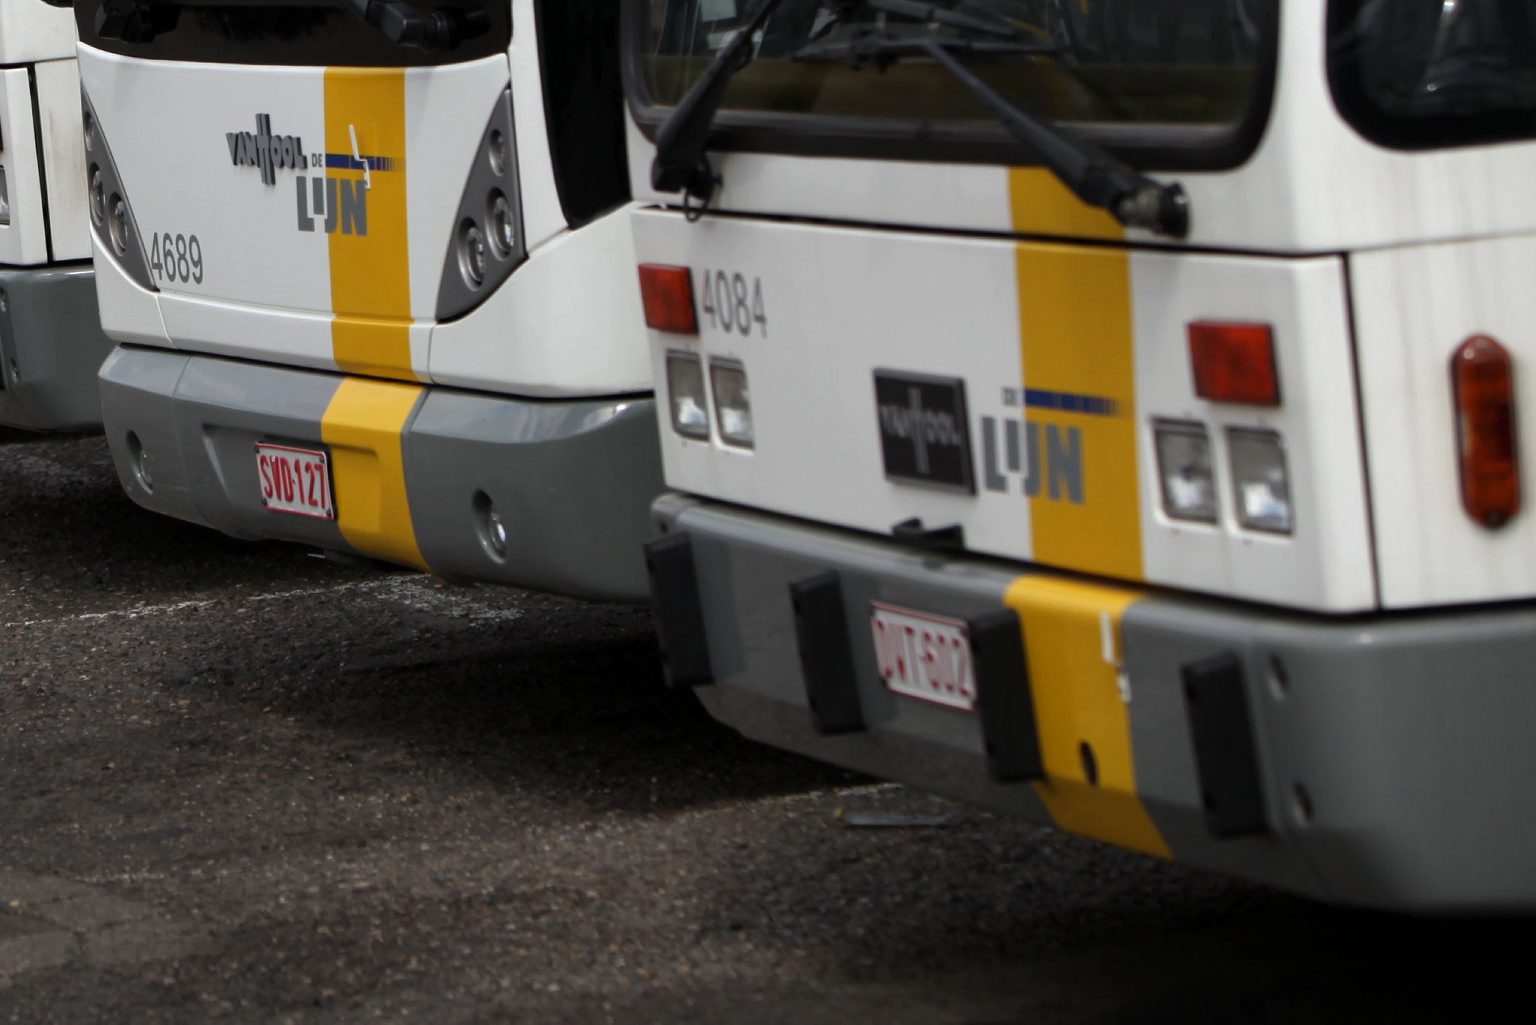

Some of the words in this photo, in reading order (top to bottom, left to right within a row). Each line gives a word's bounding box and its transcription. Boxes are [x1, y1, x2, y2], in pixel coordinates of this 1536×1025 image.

[296, 176, 368, 237] LIJN
[151, 232, 203, 285] 4689
[702, 268, 768, 340] 4084
[981, 415, 1086, 506] LIJN
